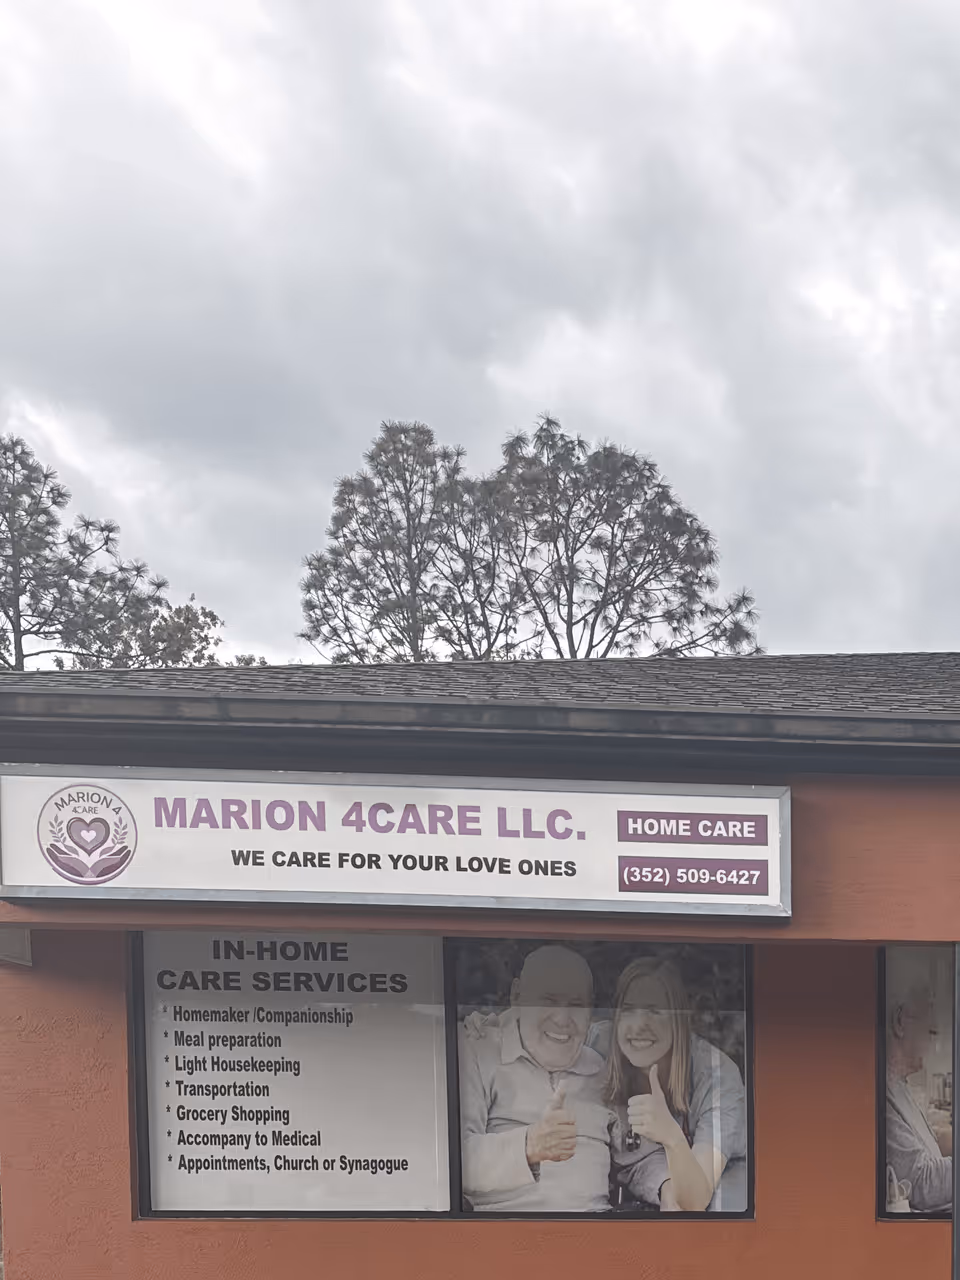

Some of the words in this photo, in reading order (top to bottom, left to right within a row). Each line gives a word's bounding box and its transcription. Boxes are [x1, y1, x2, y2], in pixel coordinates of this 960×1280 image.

[54, 792, 113, 811] MARION
[112, 806, 122, 815] 4
[154, 797, 326, 831] MARION
[342, 801, 482, 836] 4CARE
[497, 807, 586, 840] LLC.
[627, 818, 691, 836] HOME
[698, 820, 756, 837] CARE
[231, 850, 265, 866] WE
[272, 851, 331, 868] CARE
[338, 852, 381, 869] FOR
[388, 854, 449, 872] YOUR
[455, 856, 511, 874] LOVE
[518, 859, 577, 877] ONES
[623, 867, 670, 886] (352)
[676, 868, 761, 885] 509-6427
[211, 940, 349, 961] IN-HOME
[157, 970, 241, 991] CARE
[252, 971, 408, 993] SERVICES
[173, 1005, 250, 1023] Homemaker
[252, 1006, 354, 1027] /Companionship
[174, 1030, 204, 1047] Meal
[208, 1031, 282, 1050] preparation
[175, 1056, 207, 1075] Light
[211, 1056, 300, 1076] Housekeeping
[175, 1080, 270, 1100] Transportation
[176, 1104, 228, 1125] Grocery
[231, 1105, 290, 1125] Shopping
[177, 1130, 251, 1149] Accompany
[255, 1132, 268, 1146] to
[271, 1130, 321, 1147] Medical
[178, 1154, 270, 1174] Appointments,
[274, 1155, 319, 1171] Church
[322, 1158, 336, 1171] or
[339, 1155, 409, 1174] Synagogue
